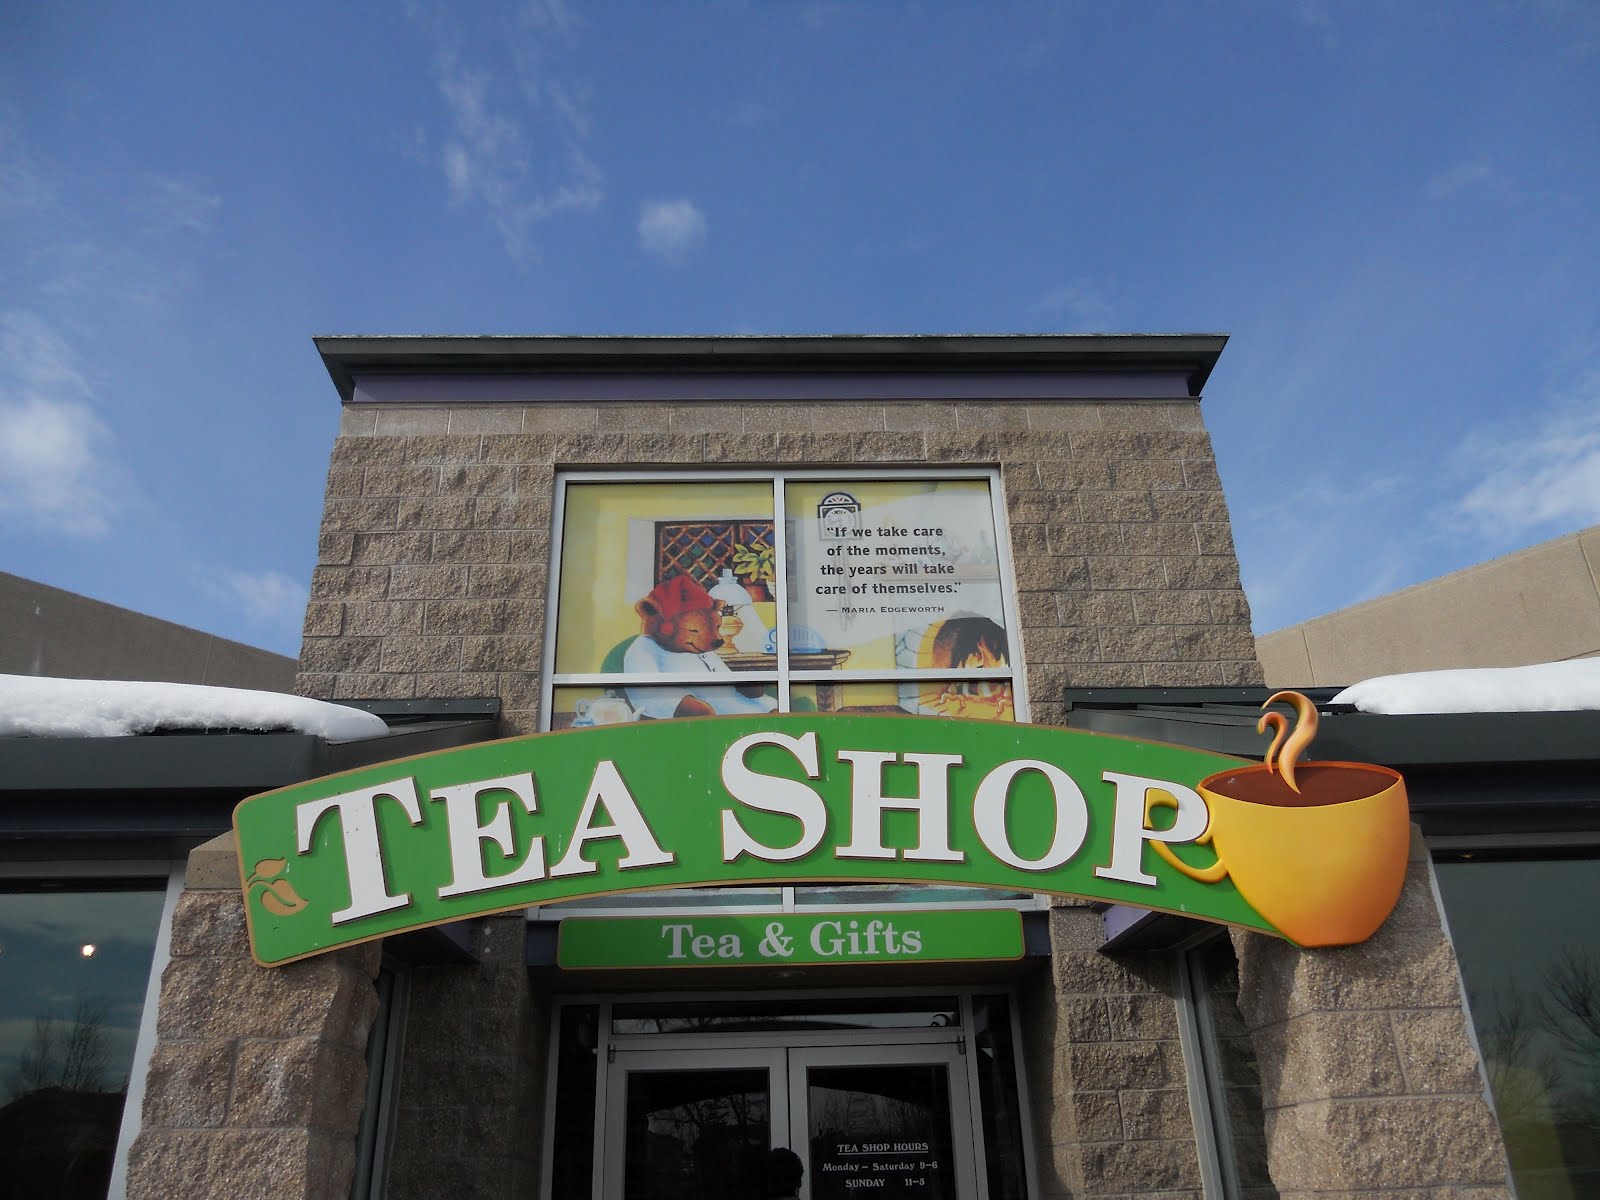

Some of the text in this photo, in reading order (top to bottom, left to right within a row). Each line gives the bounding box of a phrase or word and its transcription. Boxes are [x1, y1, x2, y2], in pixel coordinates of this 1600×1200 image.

[852, 527, 872, 537] we
[877, 526, 908, 537] take
[913, 526, 943, 536] care
[826, 544, 946, 556] of the moments,
[820, 563, 955, 577] the years will take
[815, 585, 847, 595] care
[851, 583, 868, 595] of
[296, 731, 1211, 926] TEA SHOP
[661, 920, 923, 960] Tea & Gifts
[837, 1142, 929, 1153] TEA SHOP HOURS
[822, 1163, 860, 1172] Monday
[872, 1162, 915, 1172] Saturday
[845, 1179, 885, 1188] SUNDAY
